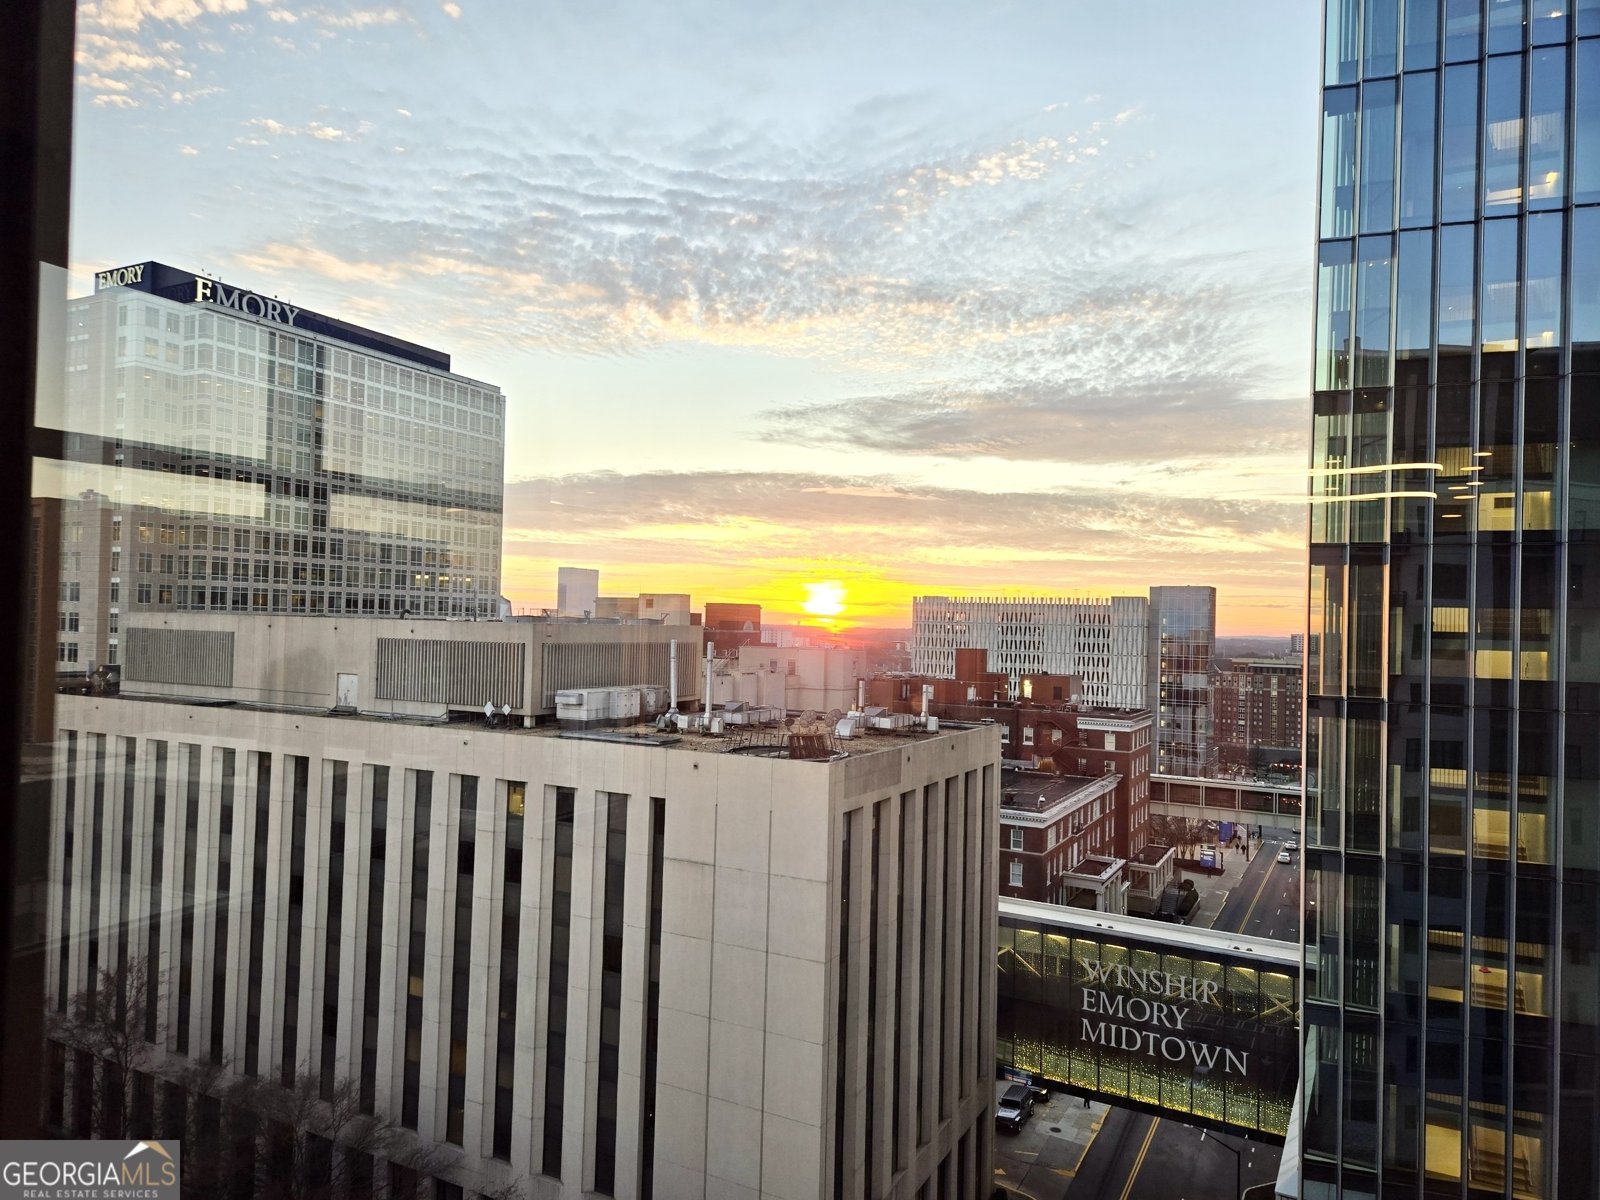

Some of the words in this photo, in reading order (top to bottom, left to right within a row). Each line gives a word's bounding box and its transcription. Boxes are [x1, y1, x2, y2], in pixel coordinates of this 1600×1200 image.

[98, 265, 144, 290] EMORY
[195, 277, 300, 326] EMORY
[1082, 958, 1218, 1003] WINSHIP
[1082, 988, 1189, 1030] EMORY
[1080, 1018, 1249, 1077] MIDTOWN
